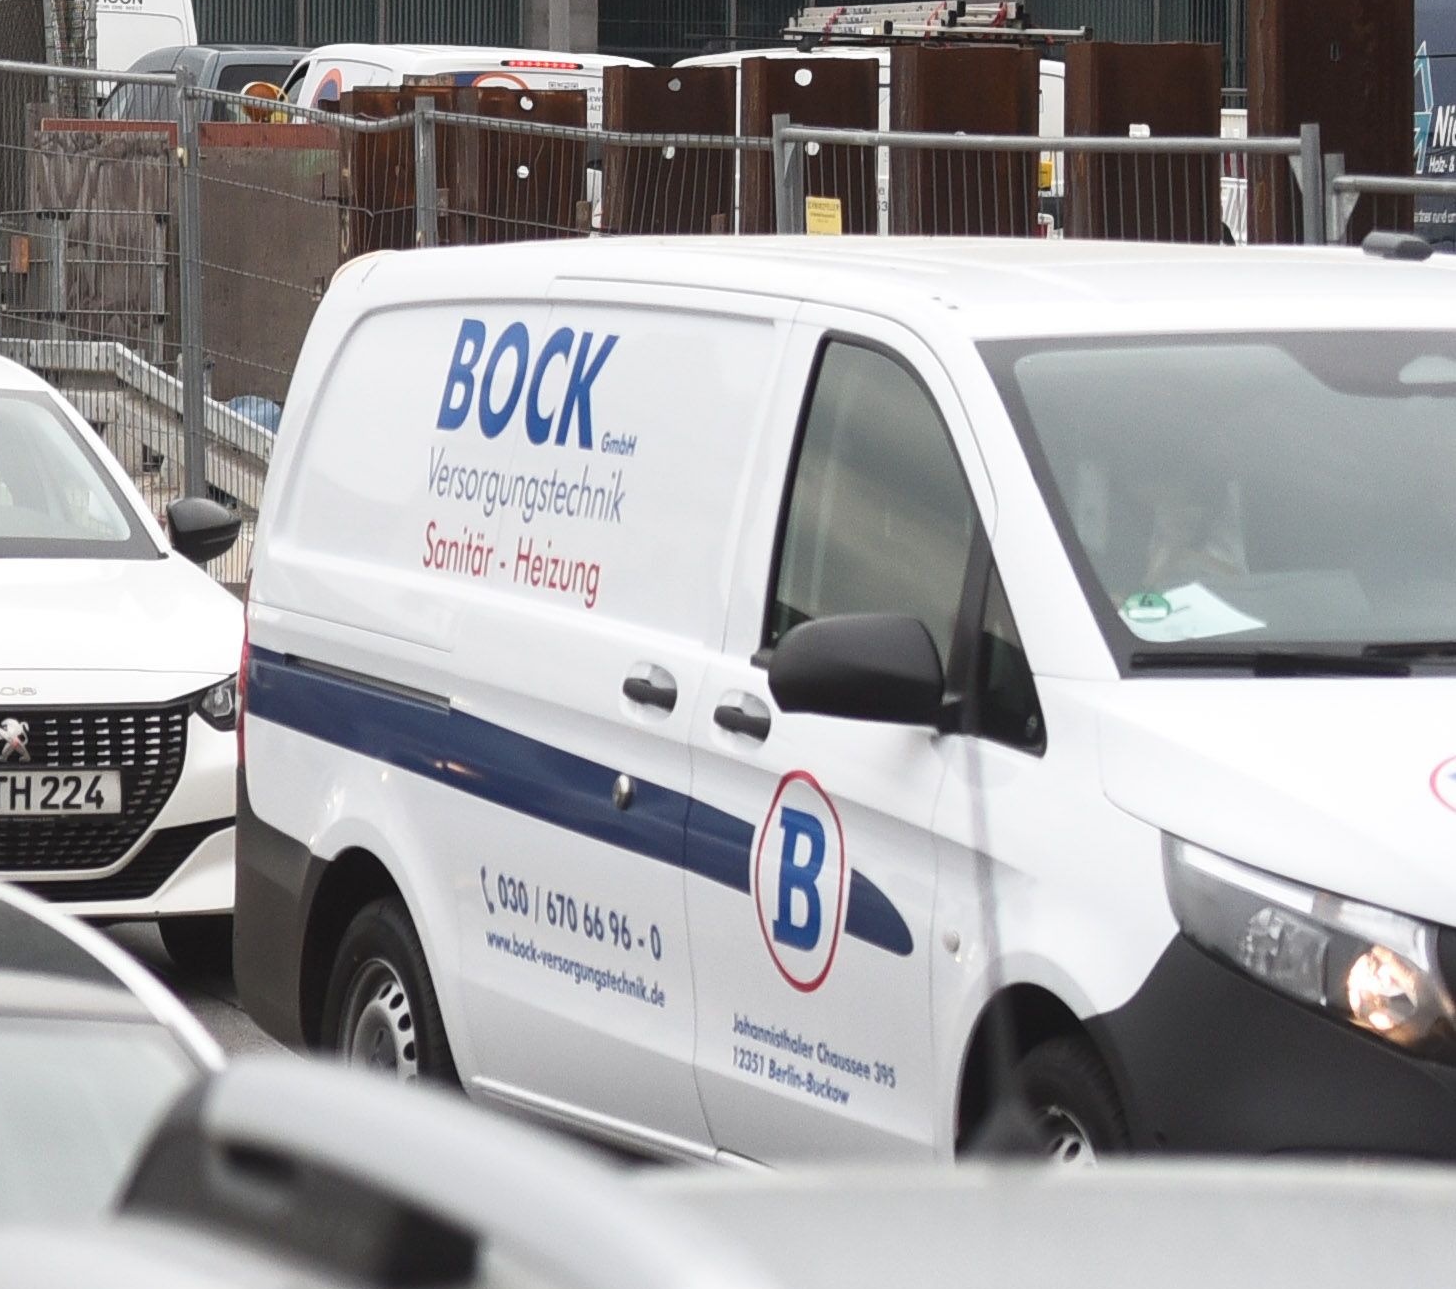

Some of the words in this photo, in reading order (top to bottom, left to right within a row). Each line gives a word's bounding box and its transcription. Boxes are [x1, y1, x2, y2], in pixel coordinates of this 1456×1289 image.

[436, 318, 620, 450] BOCK
[600, 431, 638, 456] GmbH
[428, 446, 625, 524] Versorgungstechnik
[422, 520, 494, 578] Sanitär
[513, 535, 600, 609] Heizung
[39, 775, 104, 810] 224
[497, 873, 529, 916] 030
[546, 890, 578, 933] 670
[583, 902, 604, 942] 66
[608, 910, 632, 951] 96
[650, 924, 662, 961] 0
[772, 805, 826, 951] B
[485, 929, 666, 1008] www.bock-versorgungstechnik.de
[732, 1012, 814, 1061] Johannisthaler
[816, 1041, 871, 1081] Chaussee
[732, 1045, 765, 1077] 12351
[768, 1057, 850, 1105] Berlin-Buckow
